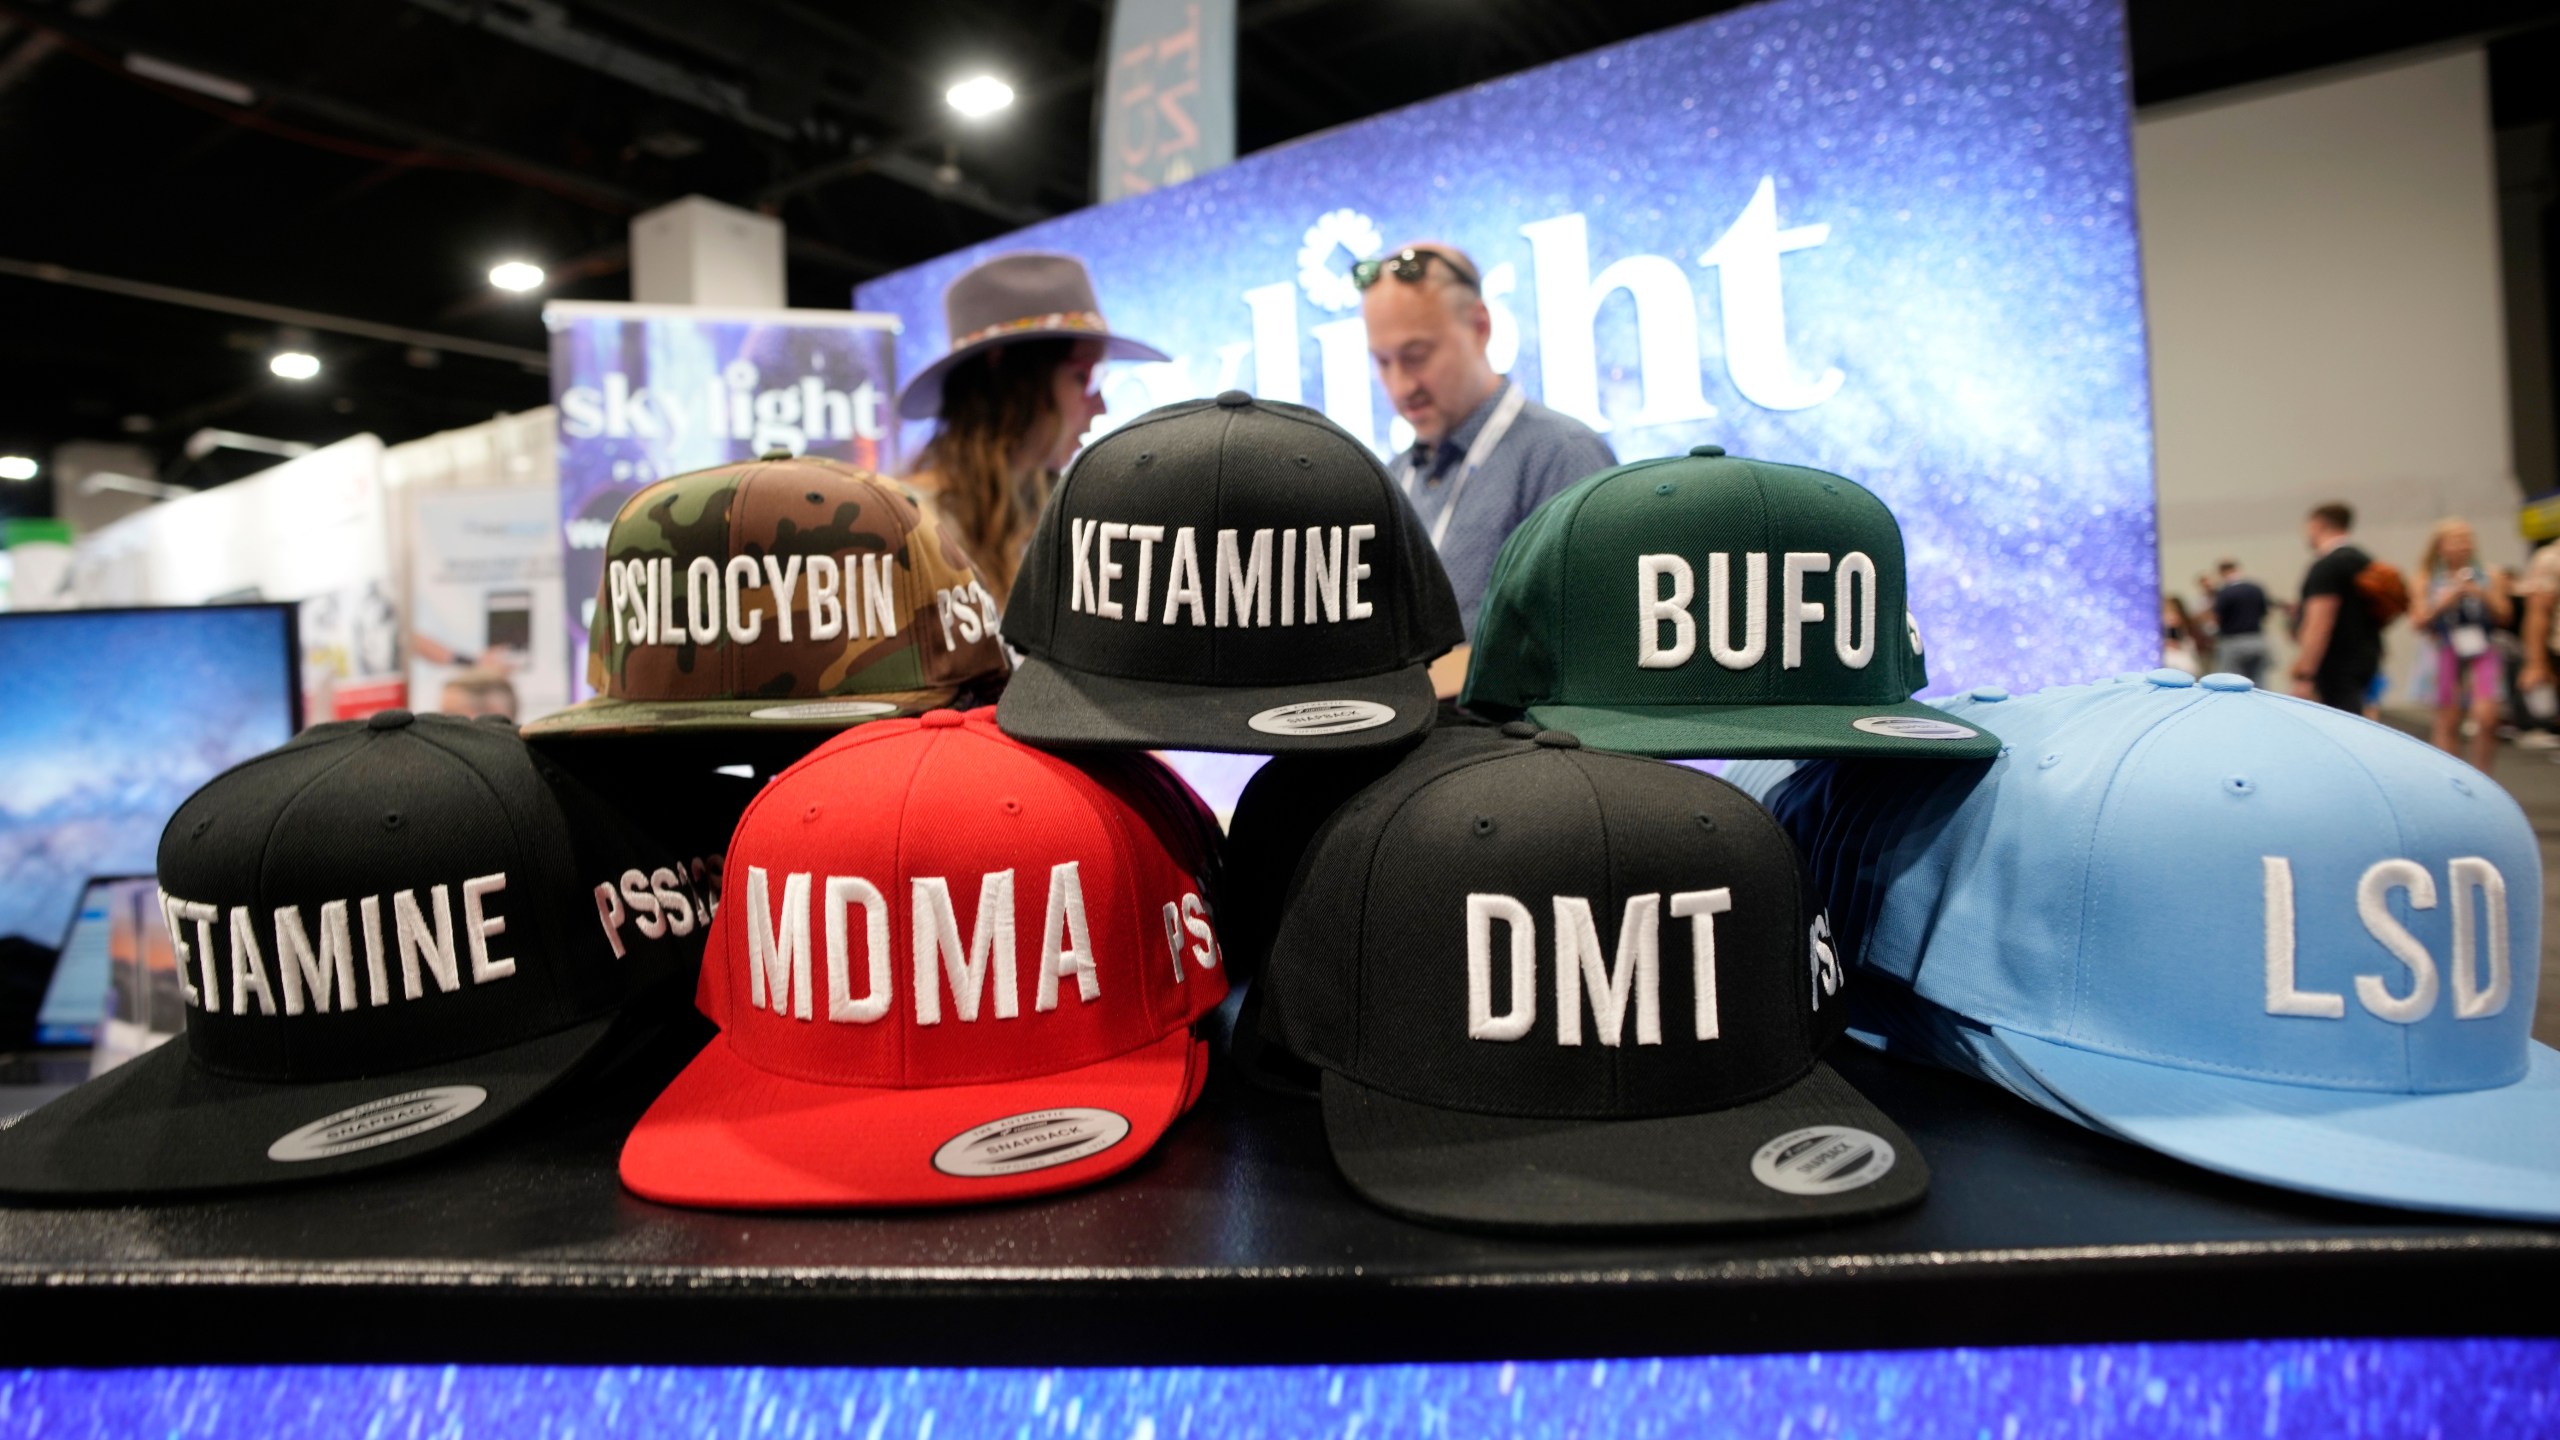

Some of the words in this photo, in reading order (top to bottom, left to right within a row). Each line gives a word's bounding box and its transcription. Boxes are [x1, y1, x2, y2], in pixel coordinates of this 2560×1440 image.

[561, 358, 888, 458] skylight
[608, 553, 898, 645] PSILOCYBIN
[1071, 518, 1375, 629] KETAMINE
[1637, 551, 1877, 670] BUFO
[746, 860, 1101, 1025] MDMA
[1163, 892, 1222, 984] PS
[1466, 887, 1732, 1047] DMT
[2261, 855, 2511, 1025] LSD
[326, 1102, 437, 1140] SNAPBACK
[985, 1125, 1084, 1156] SNAPBACK
[1000, 1110, 1066, 1128] AUTHENTIC
